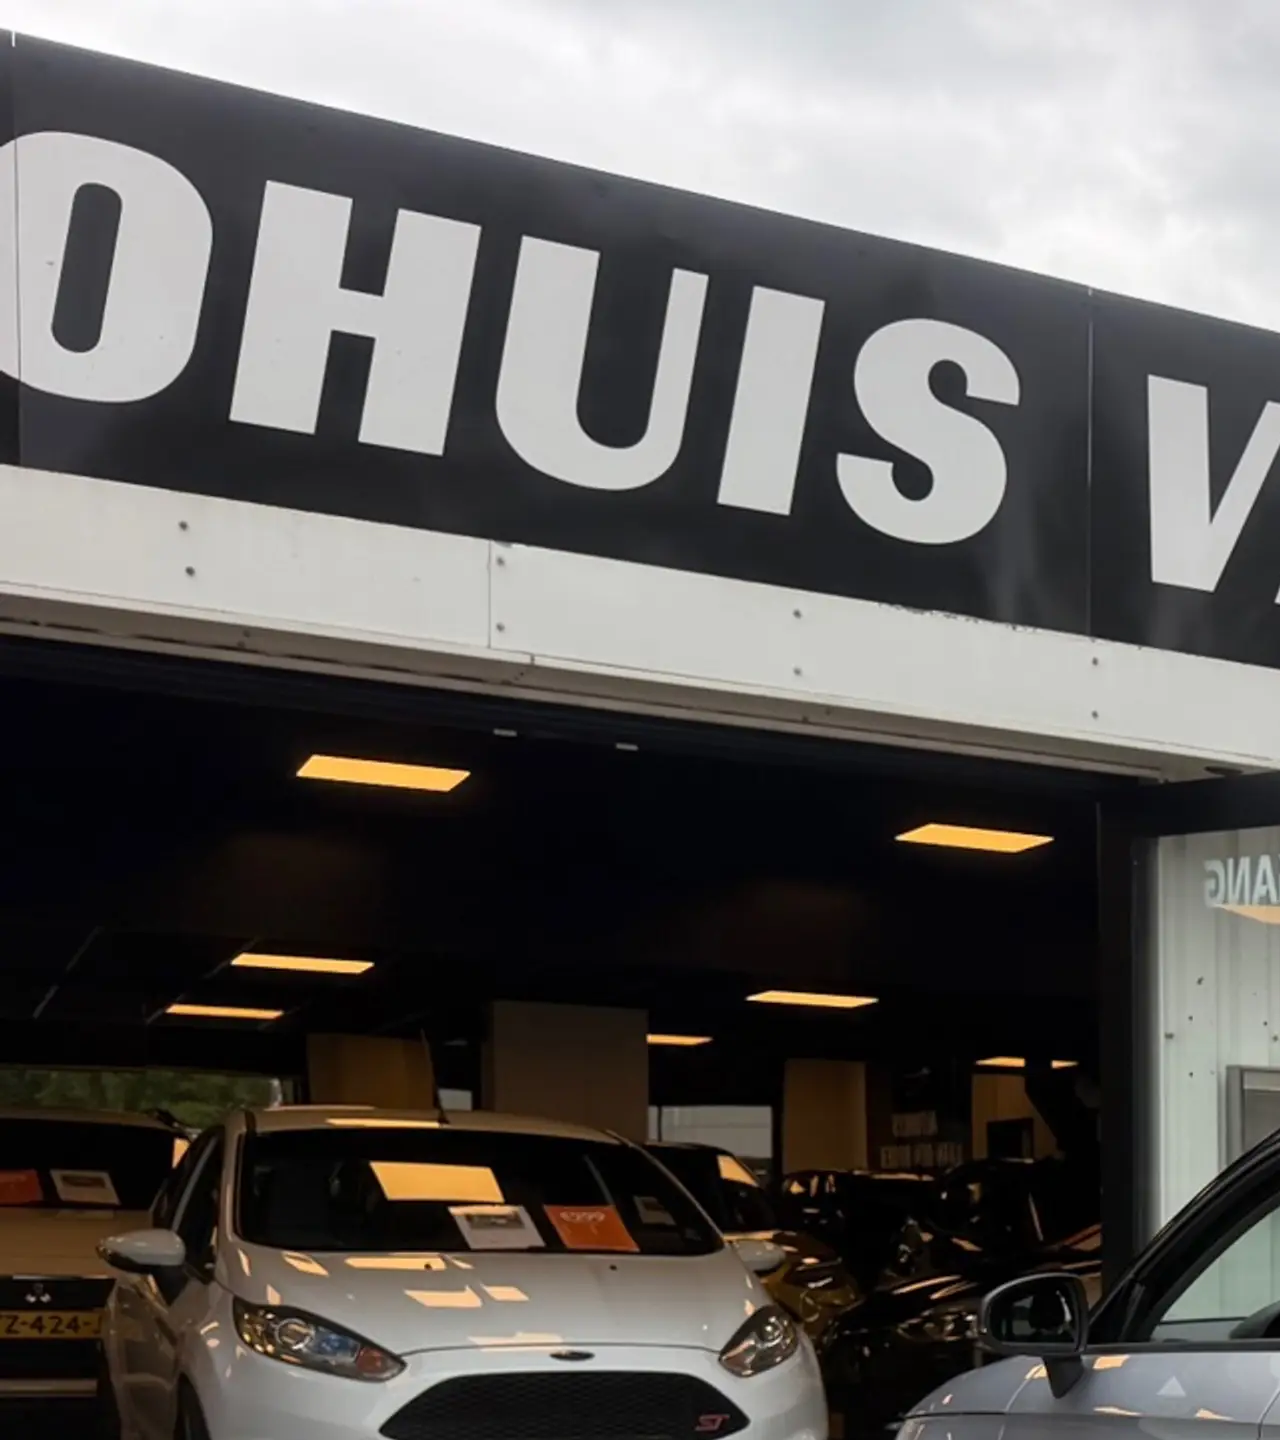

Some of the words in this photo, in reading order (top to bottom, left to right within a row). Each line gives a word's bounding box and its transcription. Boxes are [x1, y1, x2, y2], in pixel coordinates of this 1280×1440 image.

[0, 130, 1021, 545] OHUIS
[0, 1314, 102, 1335] Z-424-J
[694, 1413, 731, 1432] ST
